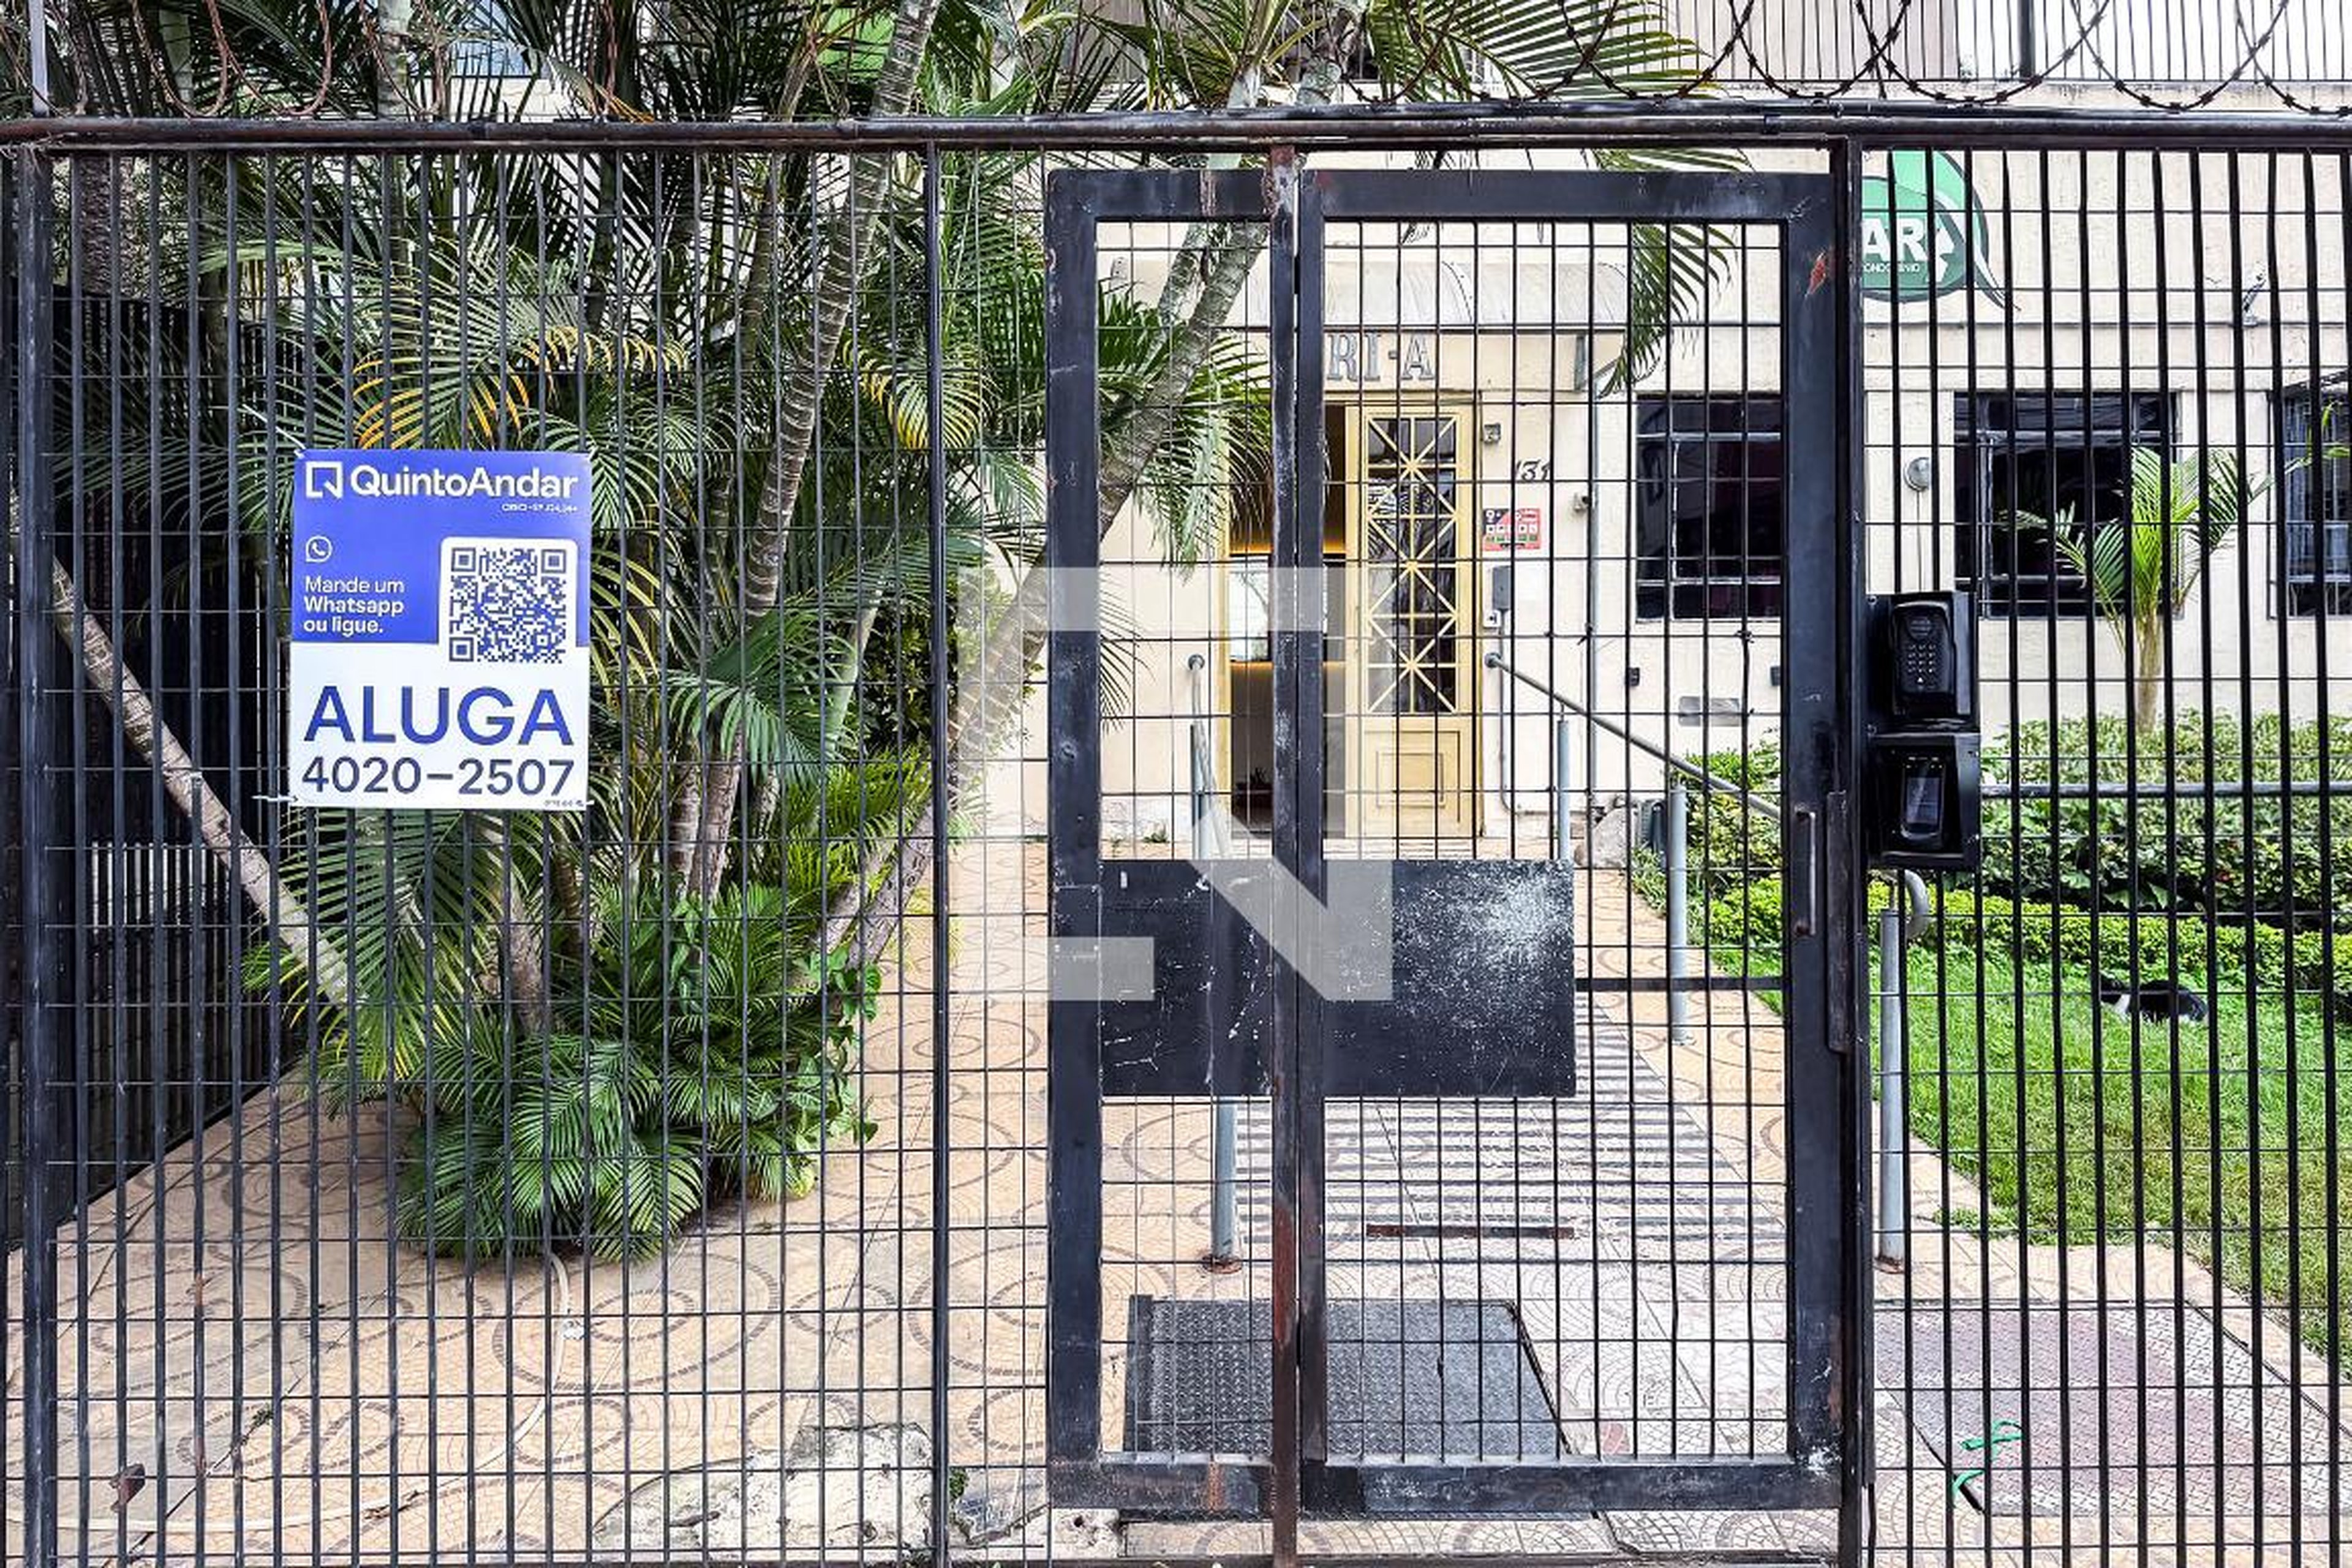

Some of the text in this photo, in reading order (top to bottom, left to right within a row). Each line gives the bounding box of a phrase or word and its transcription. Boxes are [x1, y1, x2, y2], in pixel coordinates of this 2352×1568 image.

[351, 466, 578, 498] QuintoAndar
[305, 576, 404, 594] Mande um
[304, 596, 404, 616] Whatsapp
[304, 616, 383, 637] ou ligue.
[303, 685, 574, 745] ALUGA
[302, 756, 574, 796] 4020-2507
